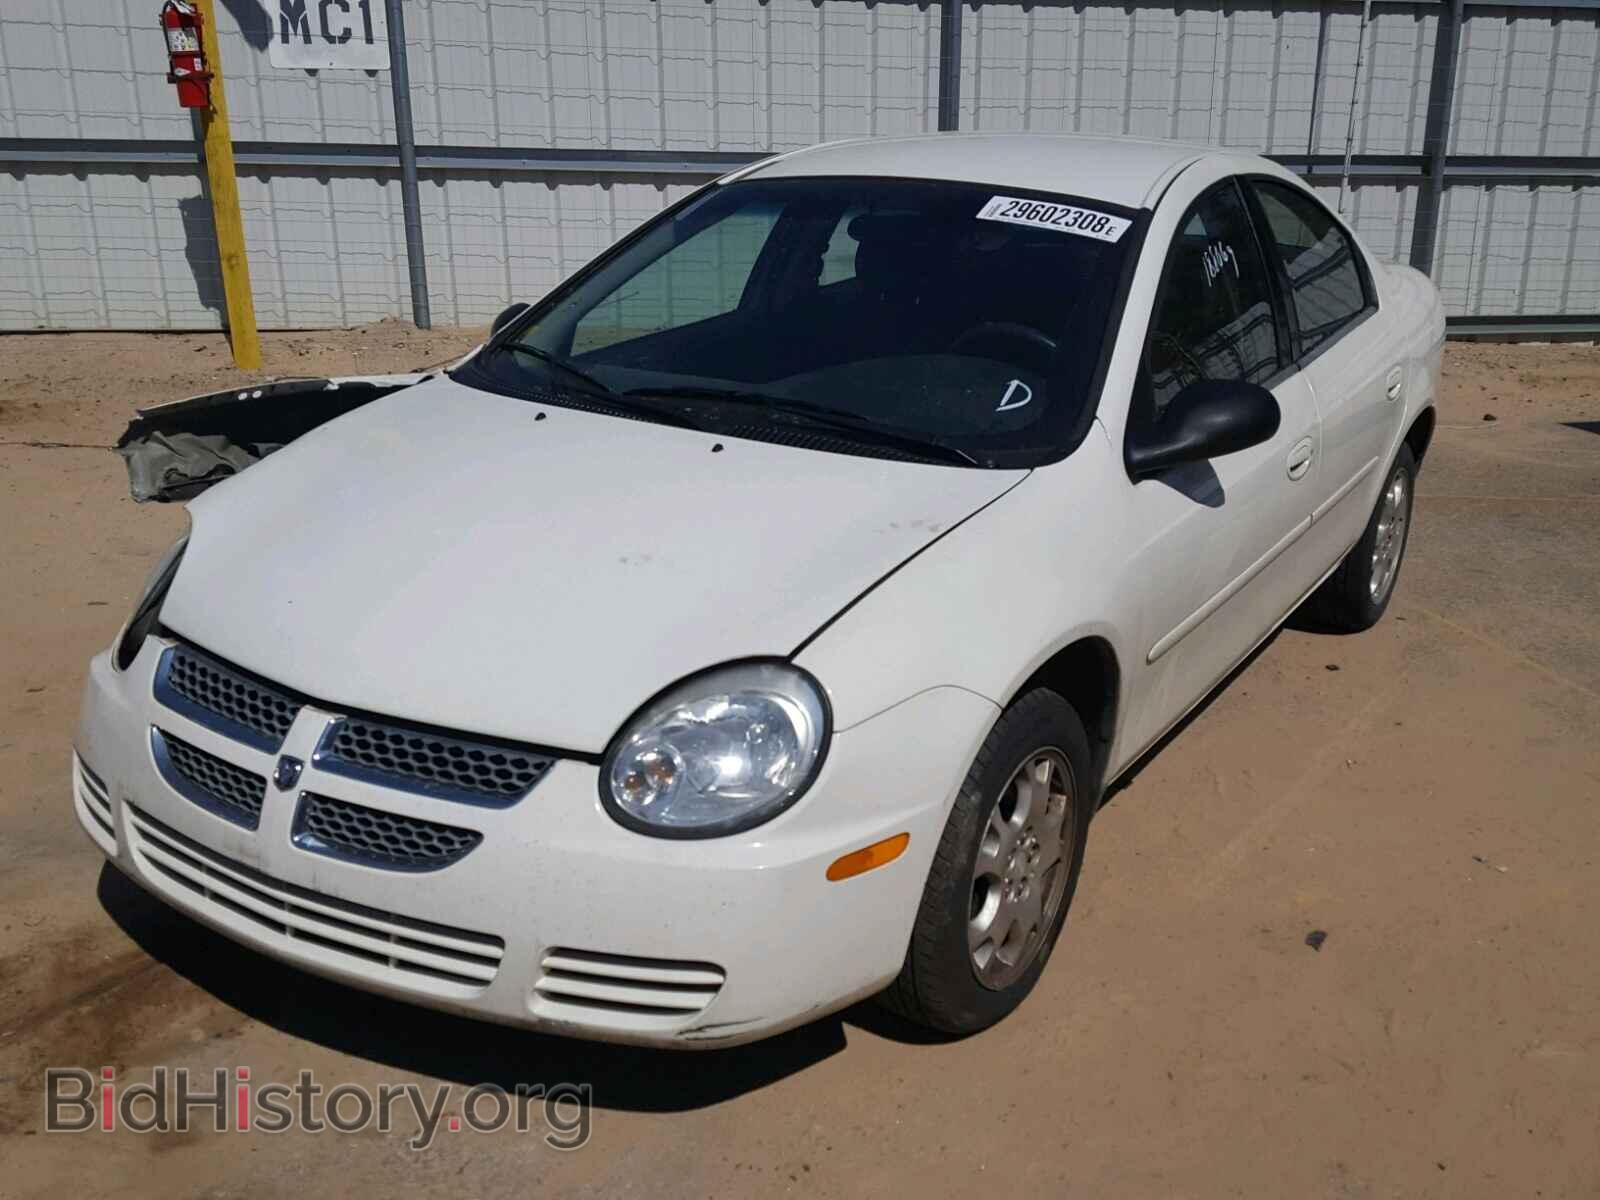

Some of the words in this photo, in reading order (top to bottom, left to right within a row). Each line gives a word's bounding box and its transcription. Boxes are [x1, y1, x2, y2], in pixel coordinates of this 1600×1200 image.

[280, 0, 375, 44] MC1
[1000, 200, 1110, 233] 29602308
[1105, 226, 1118, 236] E
[995, 379, 1032, 411] D
